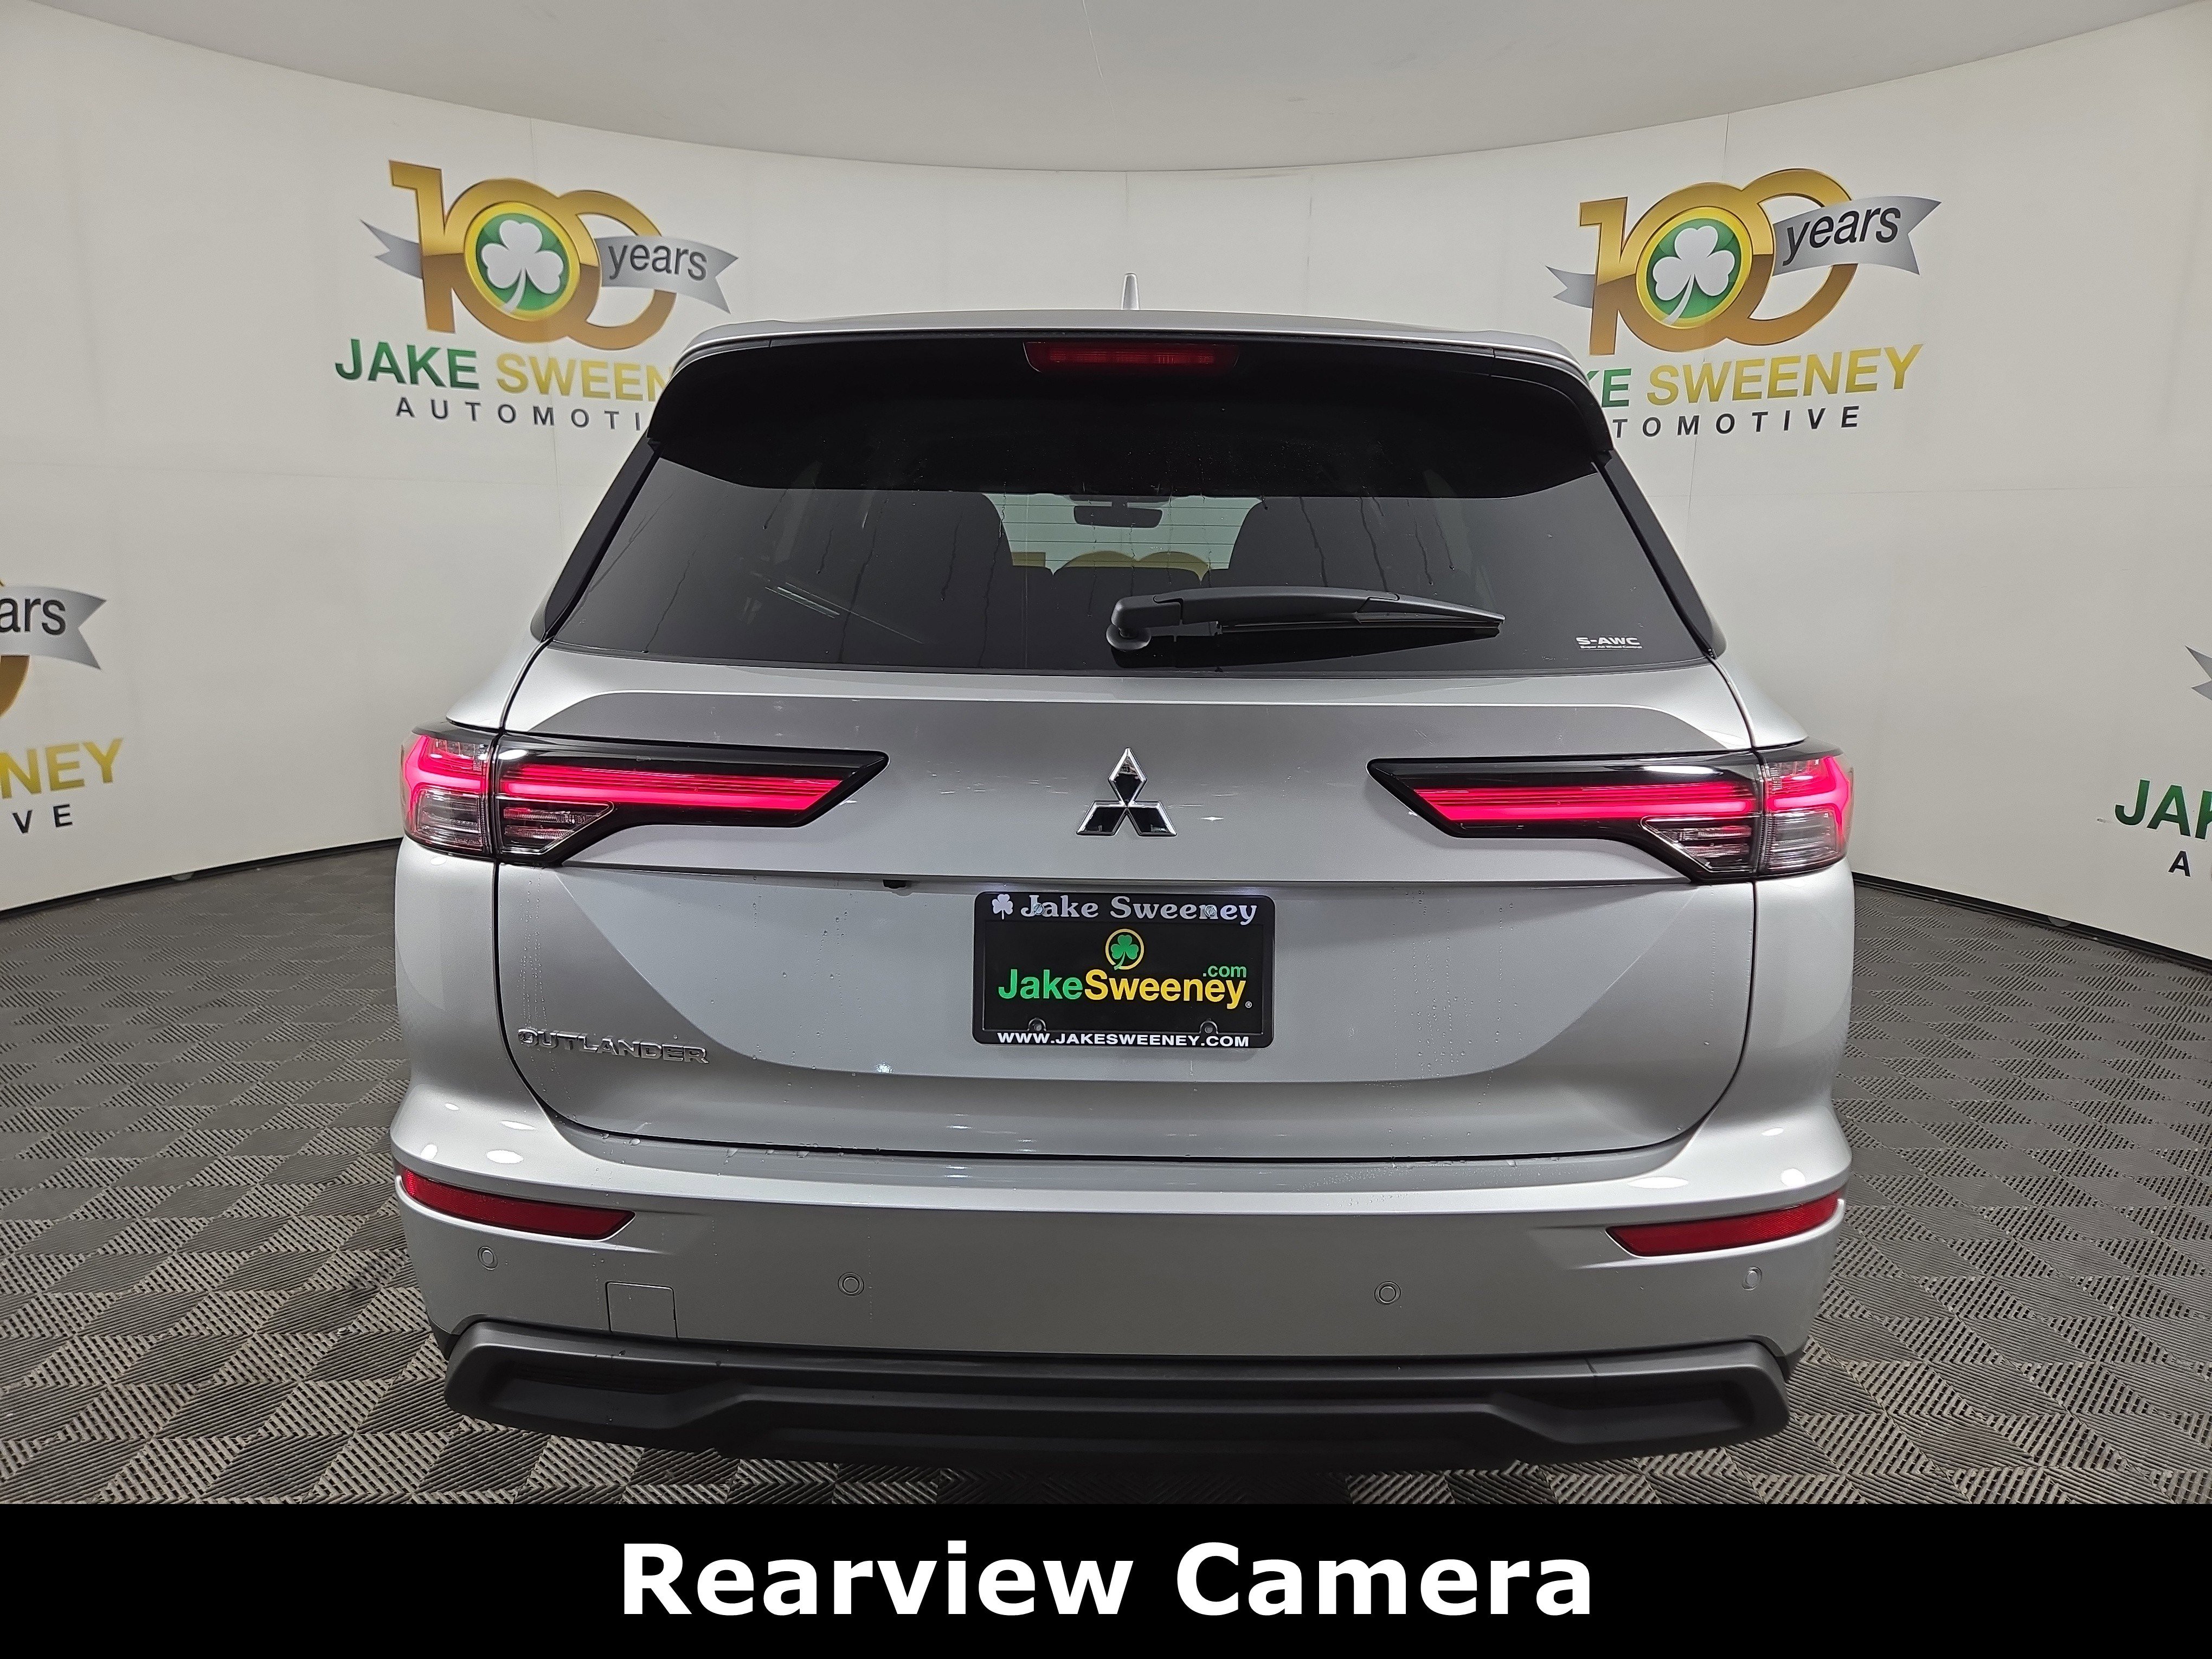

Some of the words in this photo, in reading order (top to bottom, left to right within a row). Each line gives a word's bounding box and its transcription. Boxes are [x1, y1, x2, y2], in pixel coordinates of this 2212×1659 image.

[1783, 207, 1900, 266] years
[608, 243, 708, 281] years
[335, 338, 480, 390] JAKE
[497, 353, 667, 402] SWEEN
[1647, 344, 1924, 406] SWEENEY
[396, 396, 640, 431] AUTOMOTI
[1612, 406, 1859, 439] TOMOTIVE
[1021, 895, 1099, 919] Jake
[1110, 896, 1257, 925] Sweeney
[517, 1028, 709, 1064] OUTLANDER
[997, 1032, 1249, 1047] WWW.JAKESWEENEY.COM
